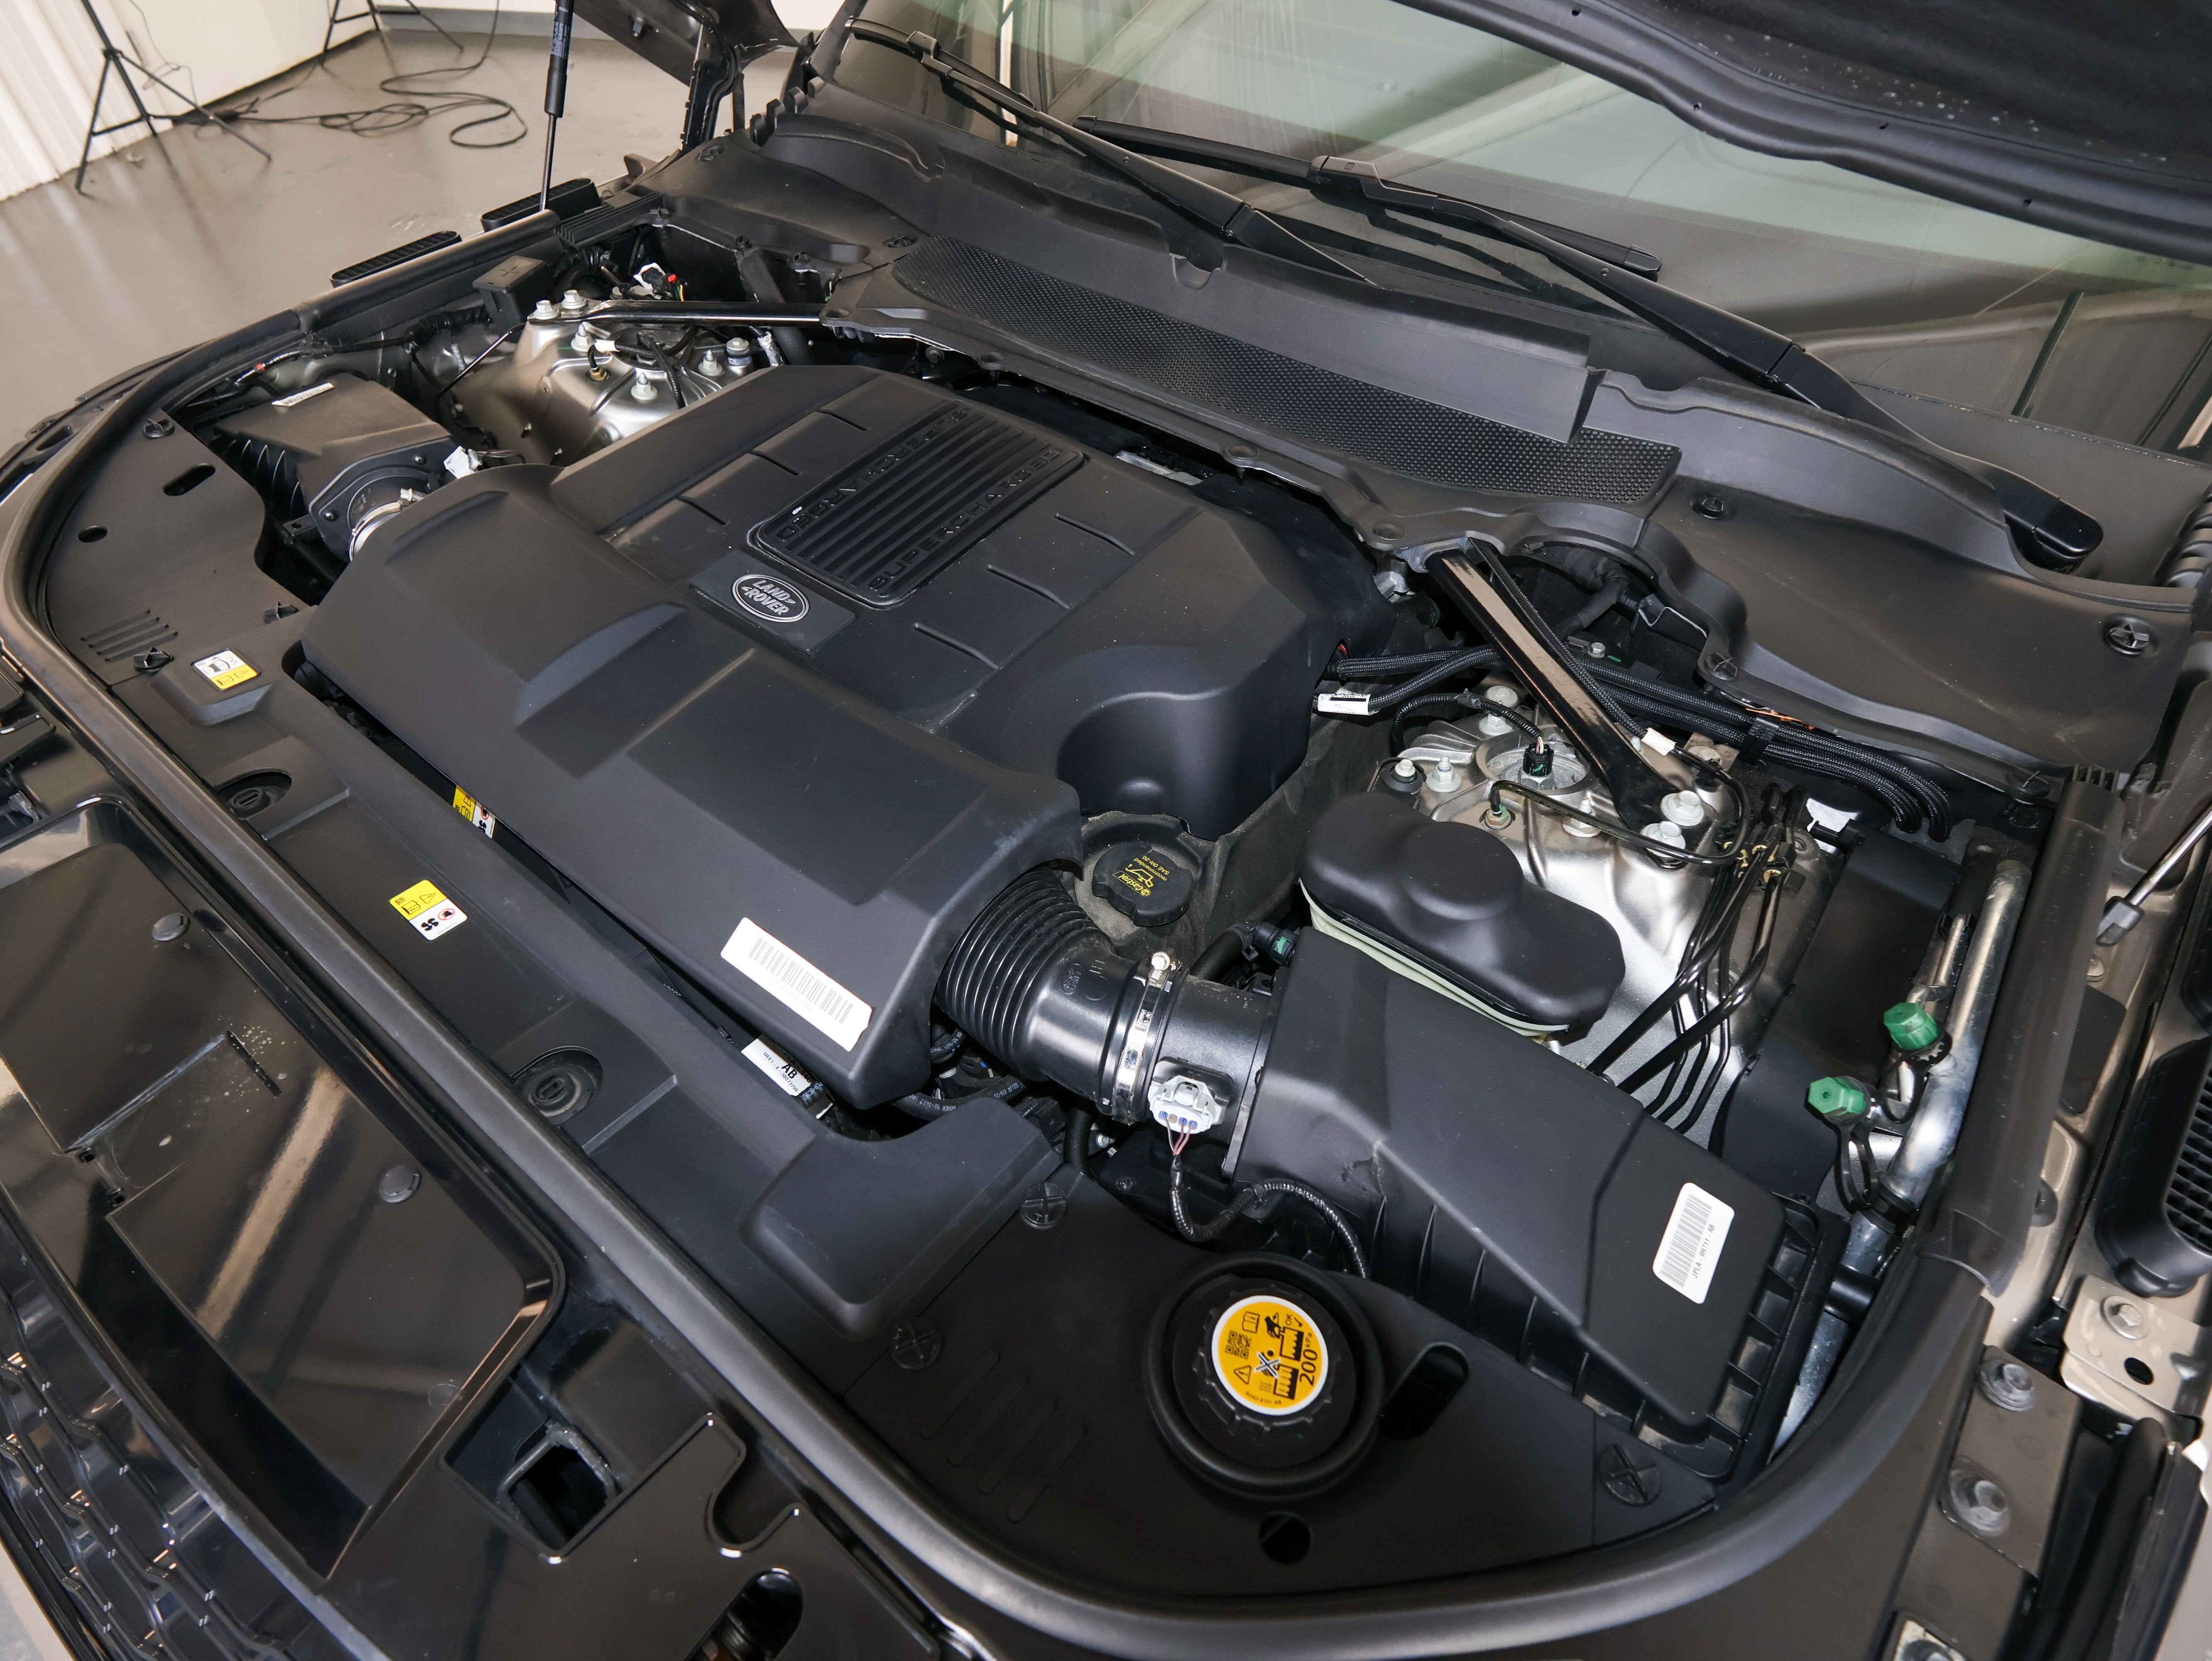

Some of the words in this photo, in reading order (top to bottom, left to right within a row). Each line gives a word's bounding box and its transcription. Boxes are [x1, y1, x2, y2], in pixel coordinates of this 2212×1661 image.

[776, 408, 969, 541] SUPERCHARGED
[867, 448, 1060, 591] SUPERCHARGED
[752, 580, 790, 600] LAND
[744, 588, 789, 615] ROVER
[1133, 858, 1167, 881] recommended
[1142, 856, 1159, 868] 0W-20
[1157, 866, 1170, 875] SAE
[1118, 873, 1144, 892] Castrol
[781, 1063, 798, 1079] AB
[1285, 1314, 1292, 1325] OK
[1299, 1349, 1317, 1386] 200
